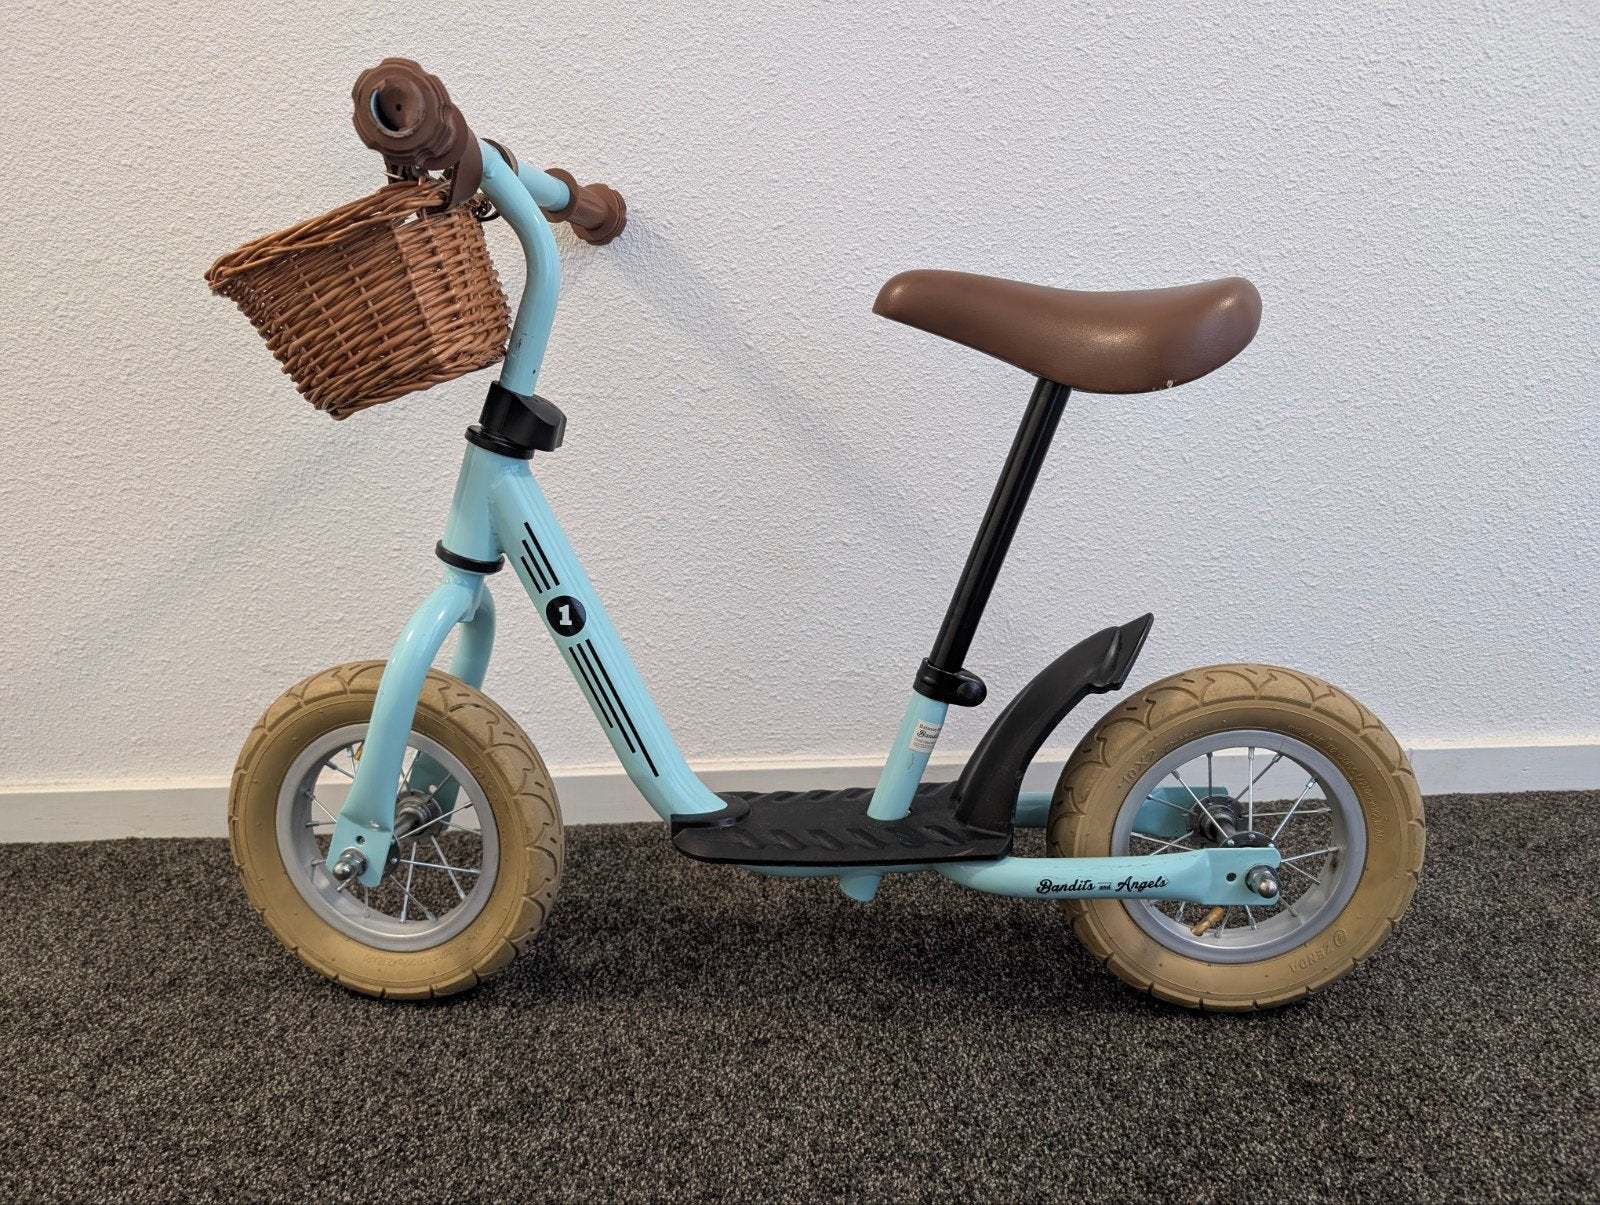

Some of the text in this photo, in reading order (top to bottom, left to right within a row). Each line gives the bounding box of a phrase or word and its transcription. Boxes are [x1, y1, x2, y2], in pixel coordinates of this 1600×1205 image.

[558, 604, 573, 626] 1
[1036, 878, 1095, 894] Bandits
[1115, 875, 1168, 892] Angels
